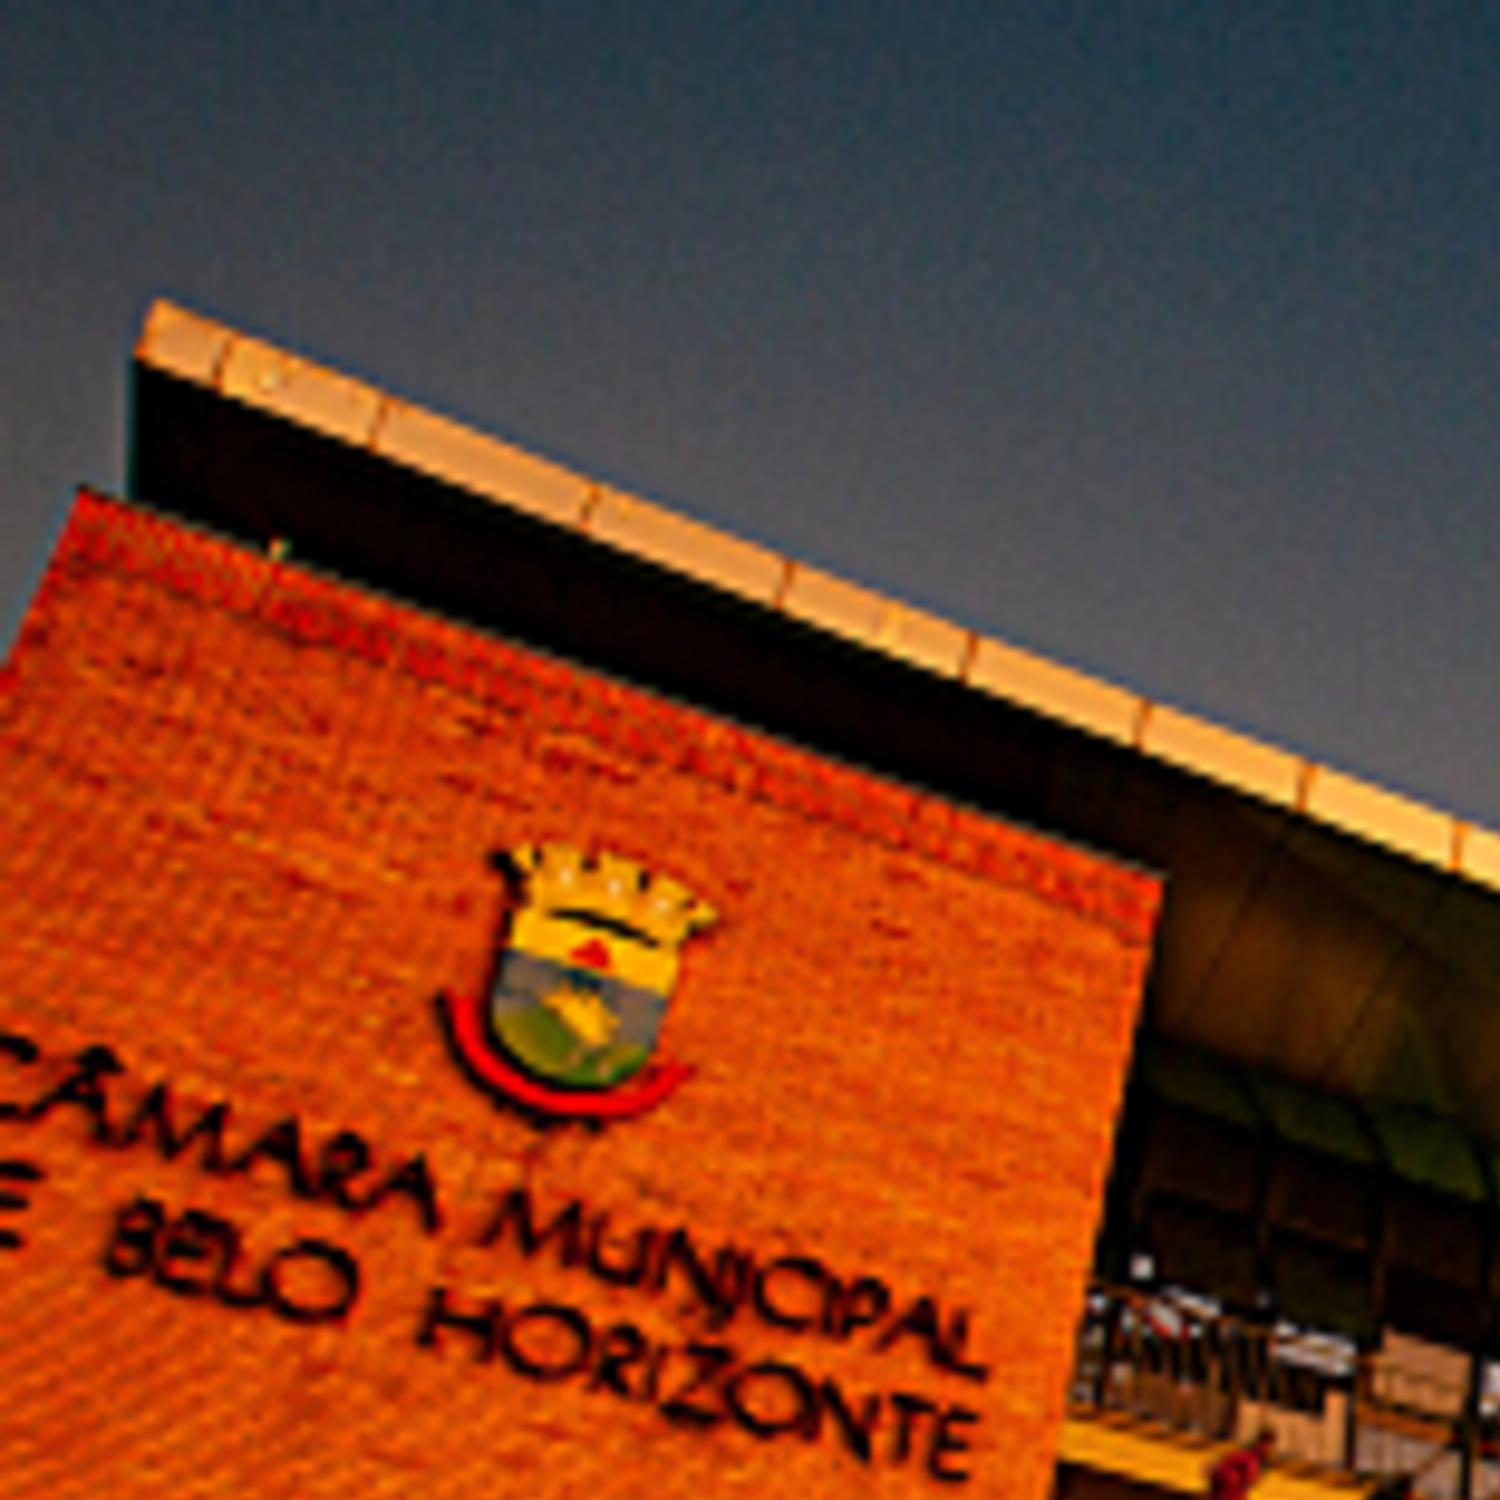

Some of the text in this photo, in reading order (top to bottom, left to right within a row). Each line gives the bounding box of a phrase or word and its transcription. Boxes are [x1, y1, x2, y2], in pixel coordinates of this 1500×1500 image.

[99, 1196, 360, 1325] BELO
[415, 1287, 980, 1484] HORIZONTE
[478, 1187, 988, 1383] MUNICIPAL
